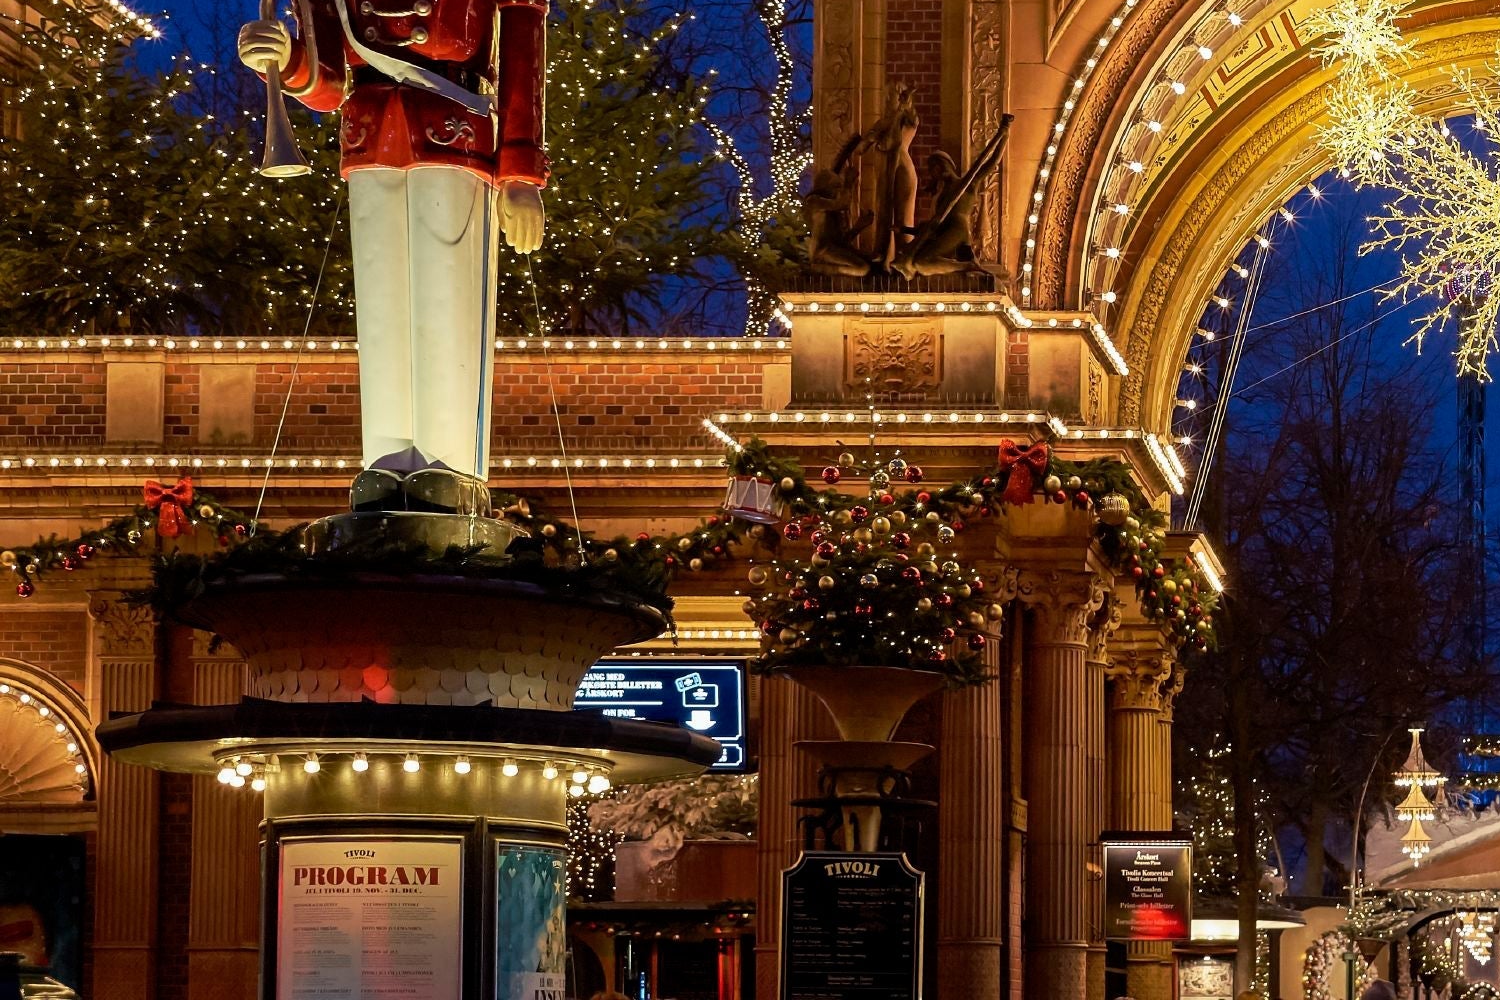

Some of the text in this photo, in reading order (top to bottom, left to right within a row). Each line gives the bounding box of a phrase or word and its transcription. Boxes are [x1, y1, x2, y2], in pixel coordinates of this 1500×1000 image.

[617, 681, 663, 690] BILLETTER
[344, 849, 376, 858] TIVOLI
[824, 861, 881, 877] TIVOLI
[294, 866, 441, 886] PROGRAM
